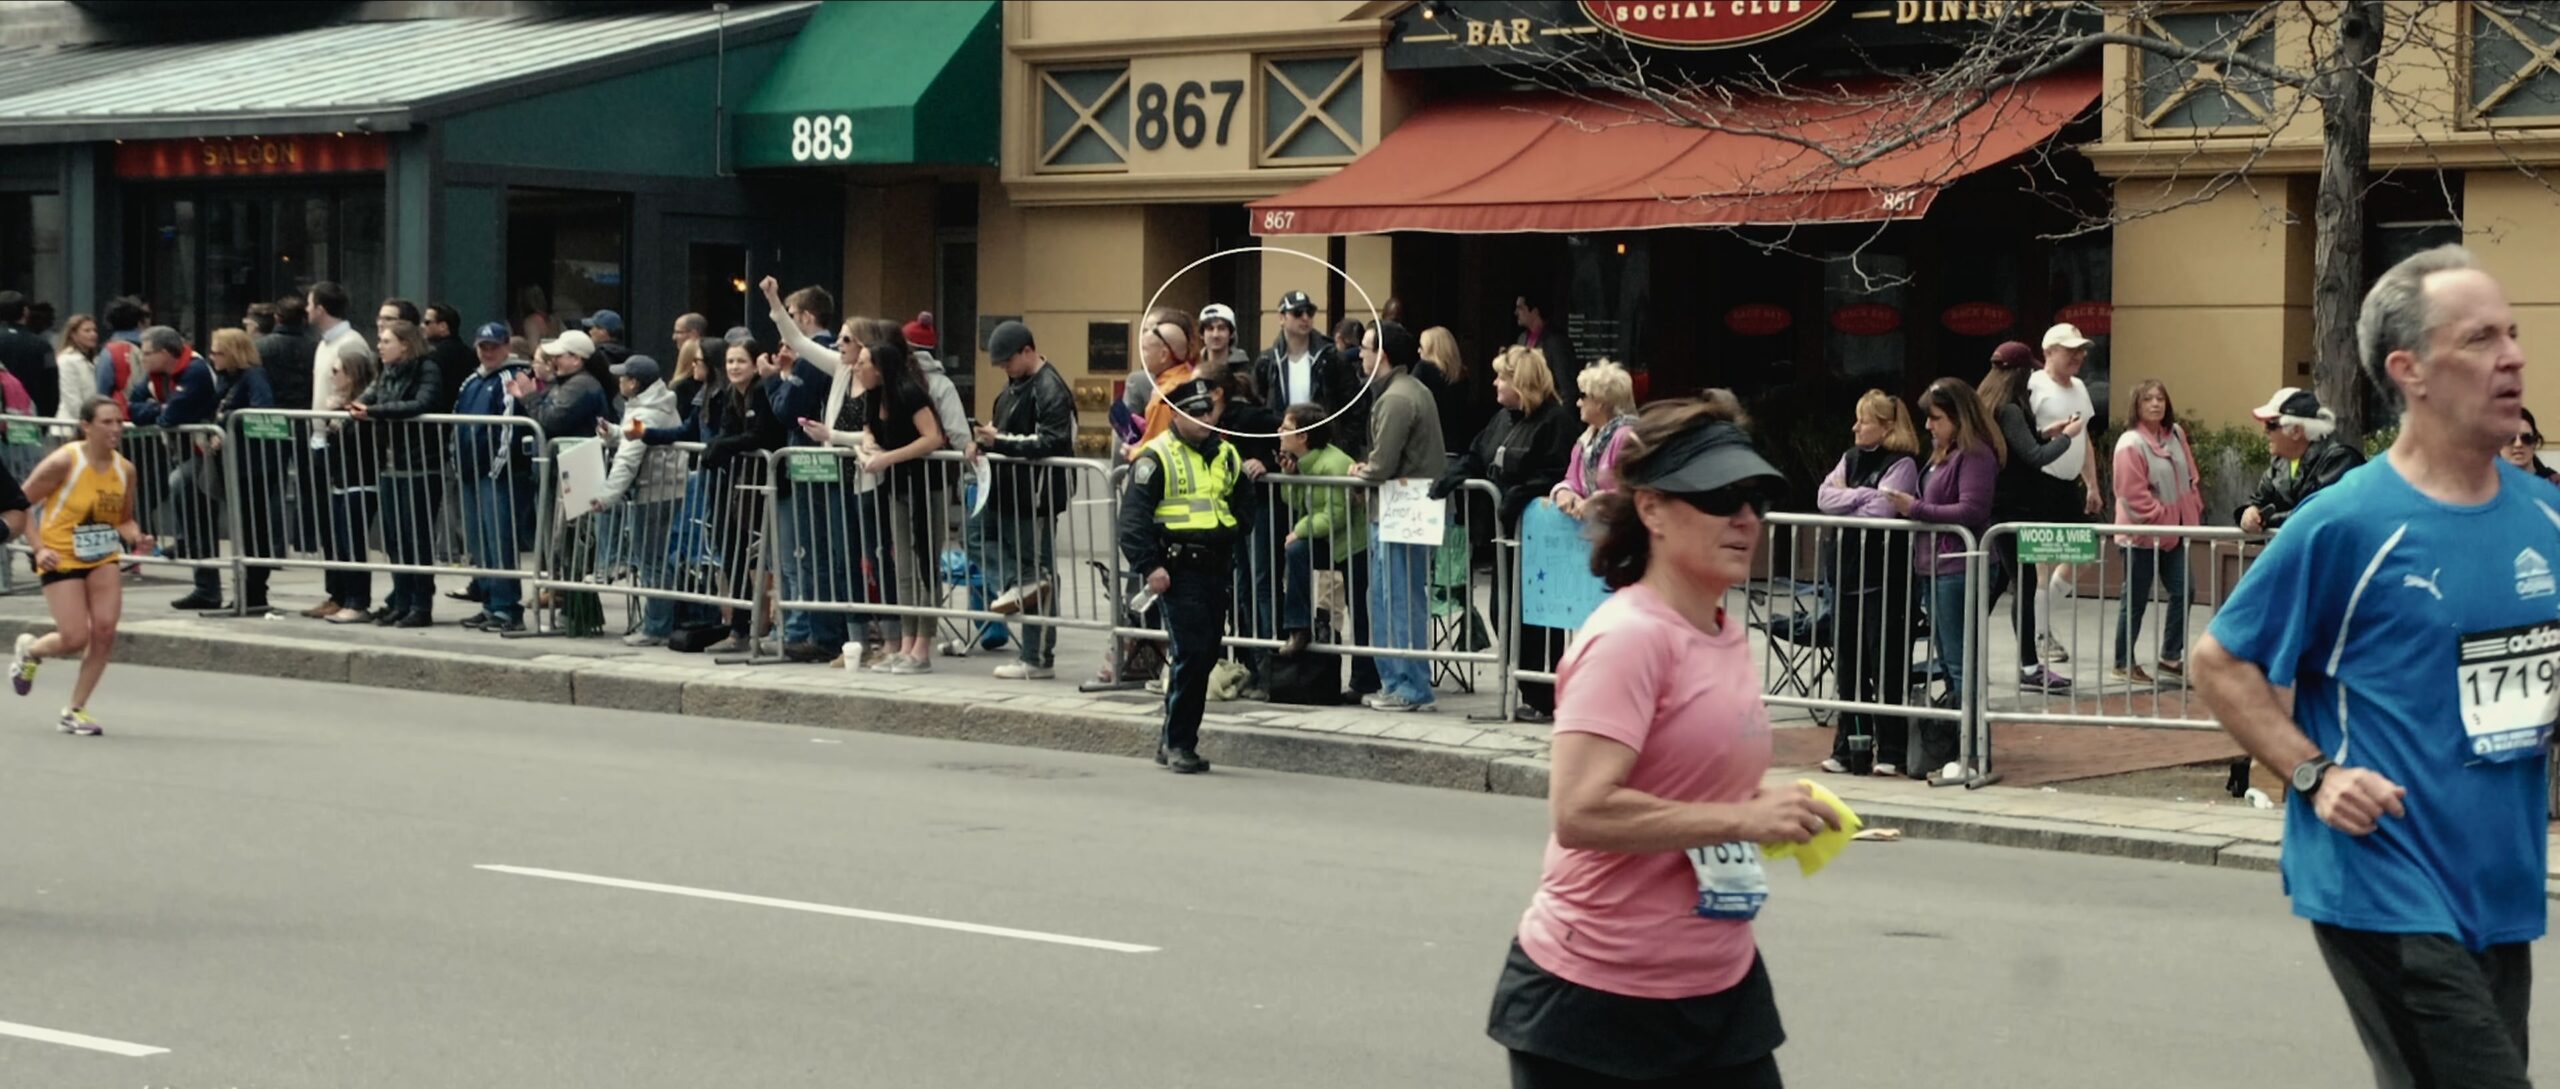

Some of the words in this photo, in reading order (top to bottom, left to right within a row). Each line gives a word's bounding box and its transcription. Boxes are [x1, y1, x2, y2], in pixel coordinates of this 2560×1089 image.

[1616, 2, 1716, 22] SOCIAL
[1731, 1, 1801, 15] CLUB
[1466, 18, 1531, 46] BAR
[1135, 80, 1244, 150] 867
[792, 114, 853, 161] 883
[203, 142, 297, 166] SALOON
[1882, 190, 1917, 211] 867
[1263, 210, 1295, 229] 867
[2020, 528, 2054, 543] WOOD
[2056, 528, 2065, 543] &
[2066, 528, 2092, 543] WIRE
[2509, 625, 2560, 653] adida
[2467, 656, 2560, 706] 1719
